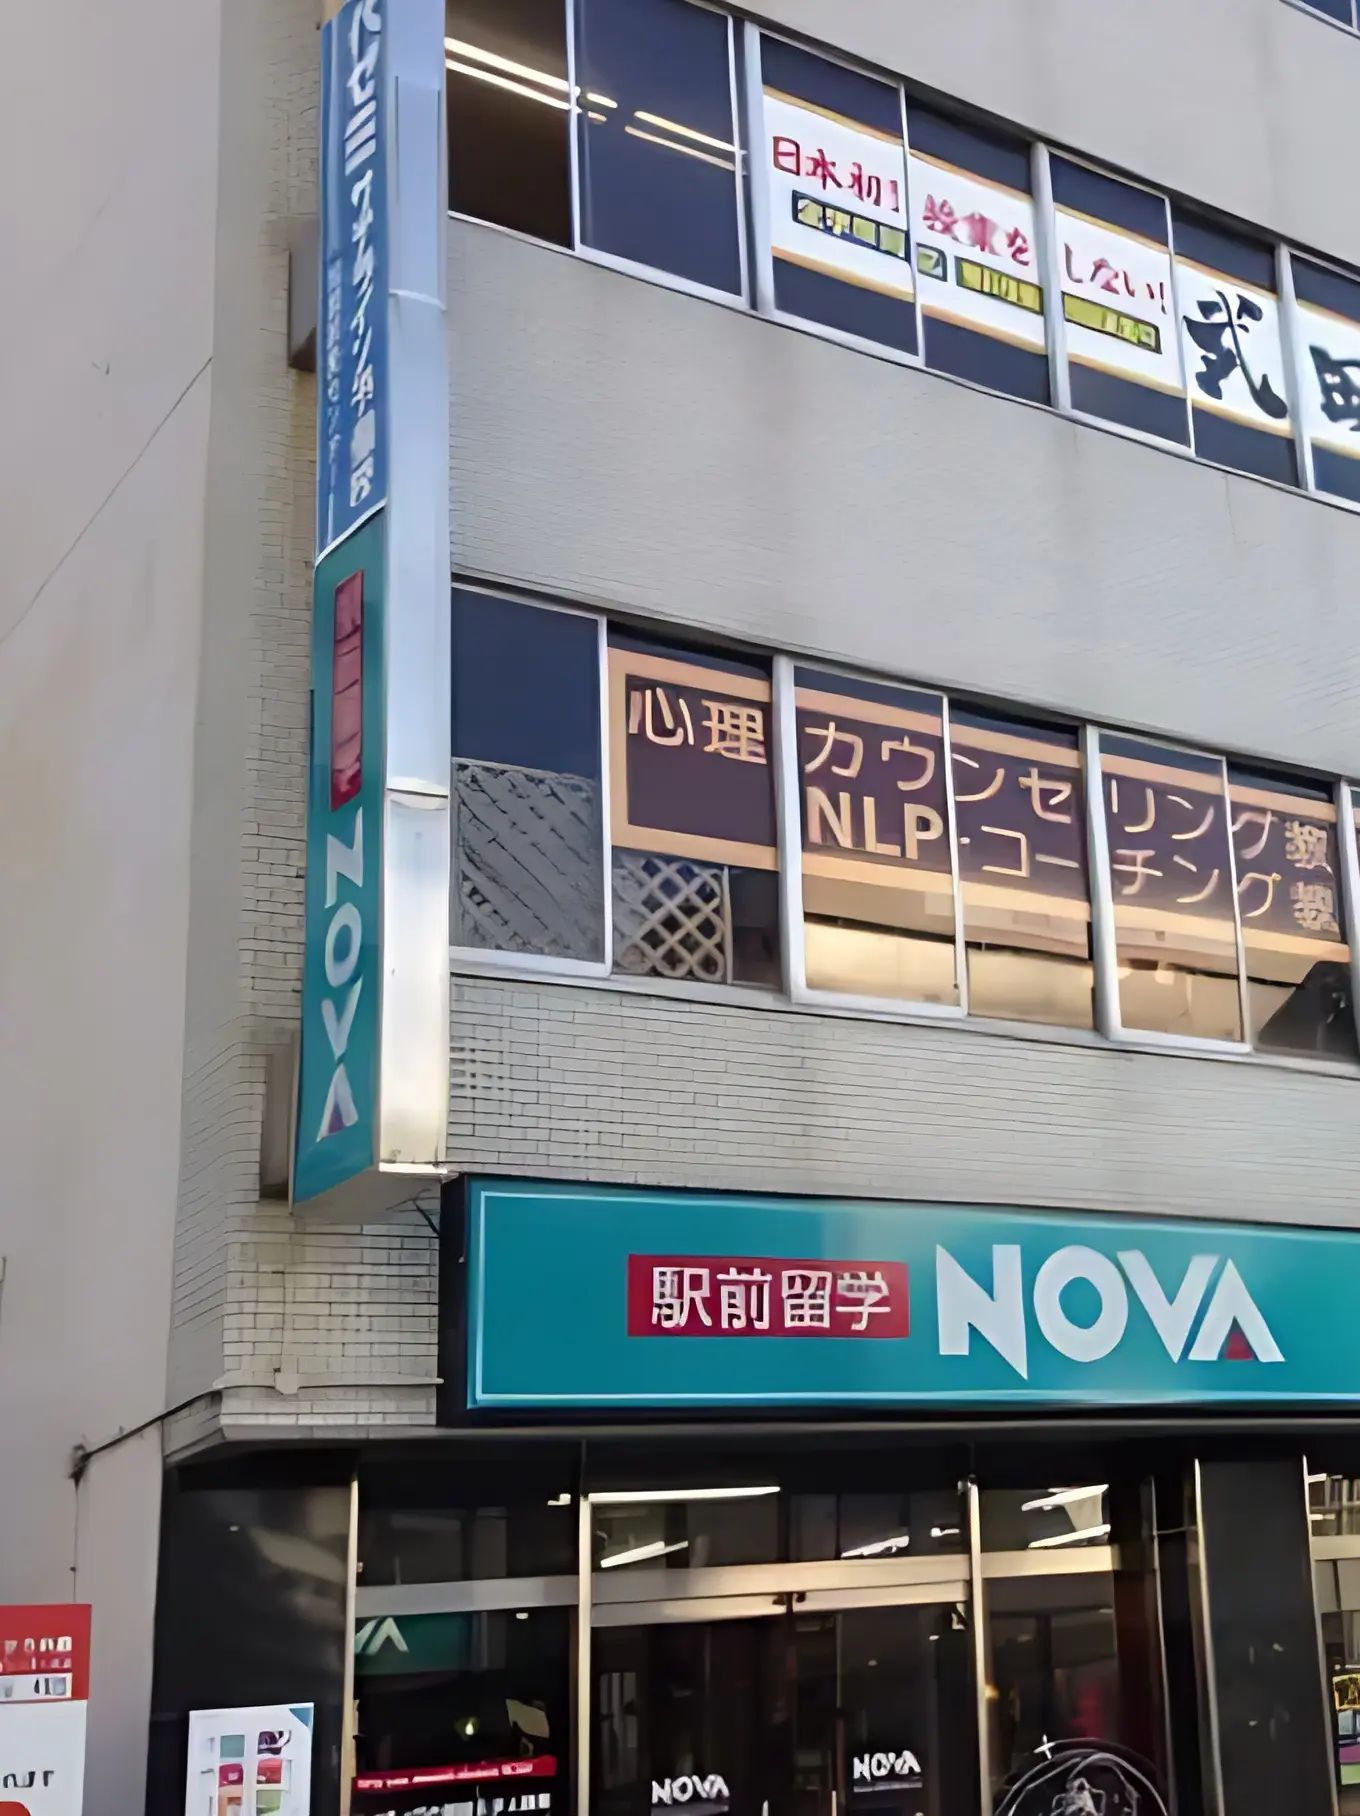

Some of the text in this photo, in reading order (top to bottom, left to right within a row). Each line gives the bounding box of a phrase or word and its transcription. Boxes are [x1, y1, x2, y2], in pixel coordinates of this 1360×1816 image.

[315, 806, 363, 1142] NOVA
[652, 1243, 1286, 1381] 駅前留学 NOVA
[652, 1773, 730, 1804] NOVA
[853, 1750, 921, 1782] NOVA
